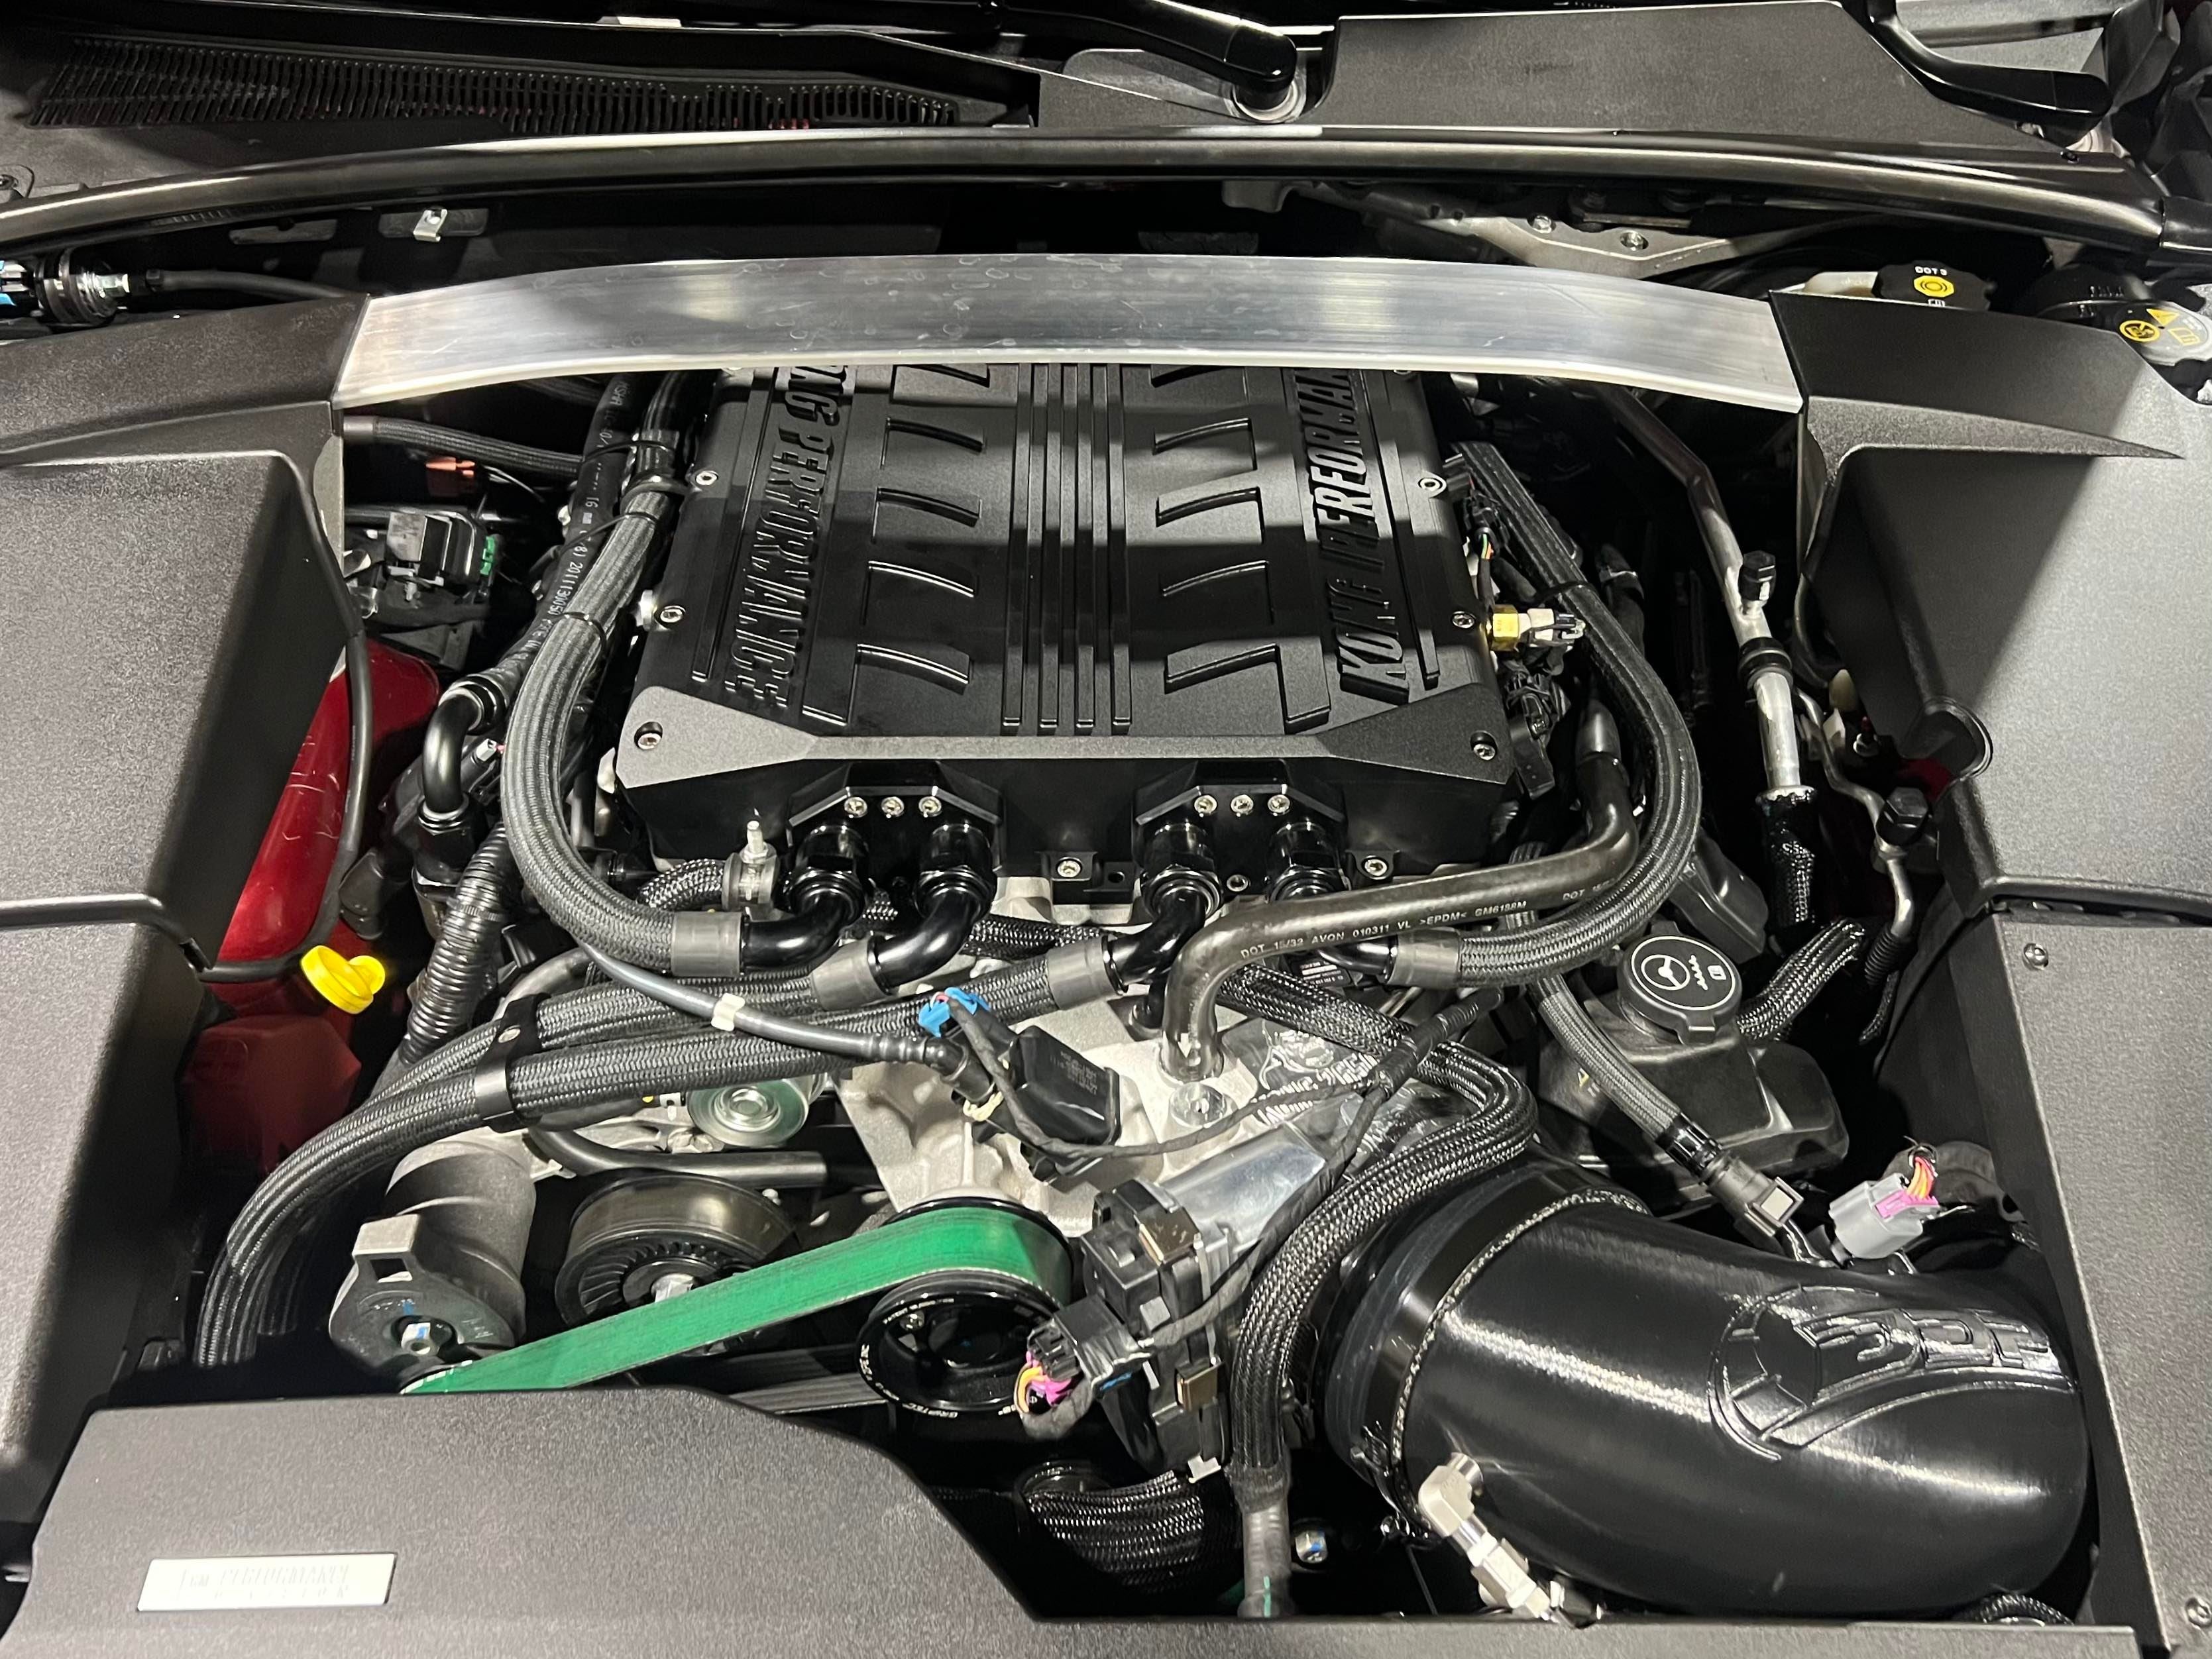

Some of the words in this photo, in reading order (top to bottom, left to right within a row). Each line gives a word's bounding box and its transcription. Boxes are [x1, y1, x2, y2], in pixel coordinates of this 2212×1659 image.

[1914, 266, 1938, 275] DOT
[724, 423, 834, 706] PERFORMANCE
[1326, 575, 1410, 696] KONG
[1562, 888, 1585, 902] DOT
[1240, 943, 1266, 959] DOT
[1311, 931, 1345, 945] AVON
[1352, 924, 1390, 938] 010311
[1397, 920, 1412, 931] VL
